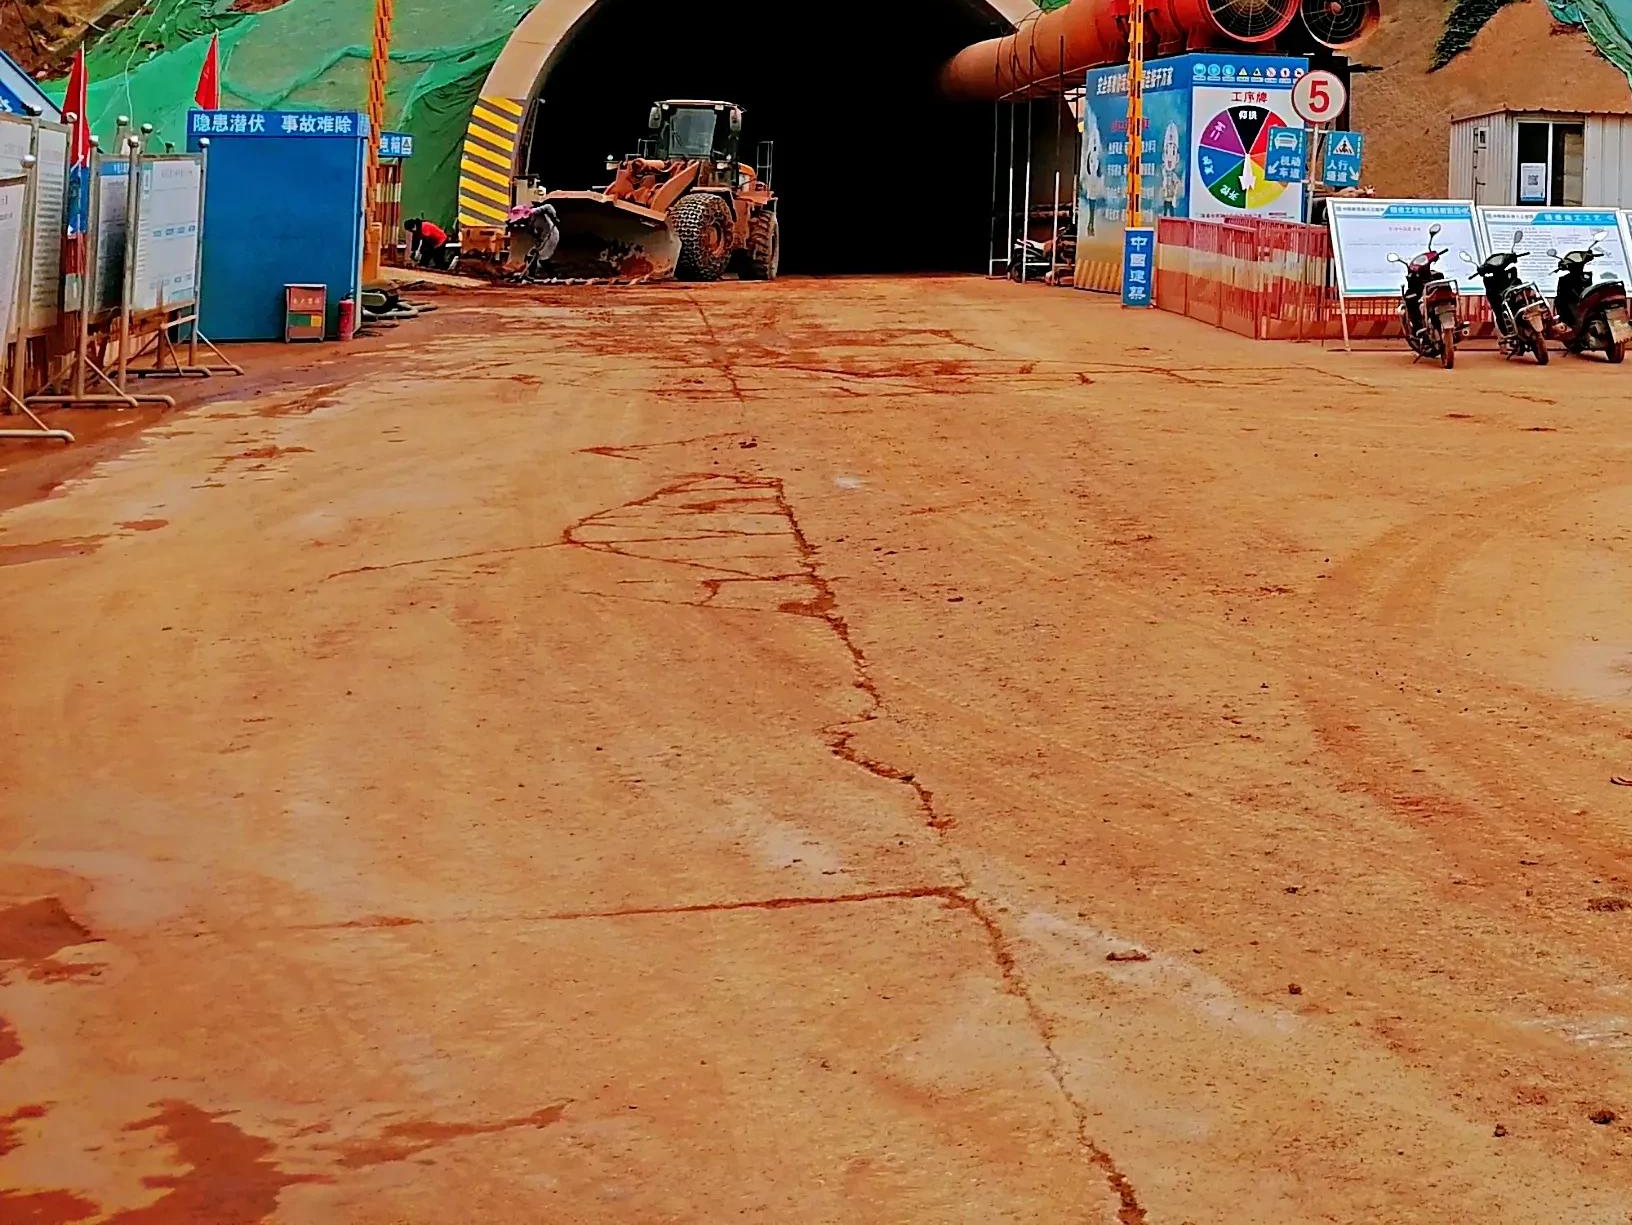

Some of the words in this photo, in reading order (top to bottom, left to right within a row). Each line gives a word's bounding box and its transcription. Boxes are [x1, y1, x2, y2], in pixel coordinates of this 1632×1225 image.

[1308, 79, 1331, 113] 5
[193, 113, 266, 133] 隐患潜伏
[280, 114, 352, 134] 事故难除
[1326, 159, 1349, 171] 人行
